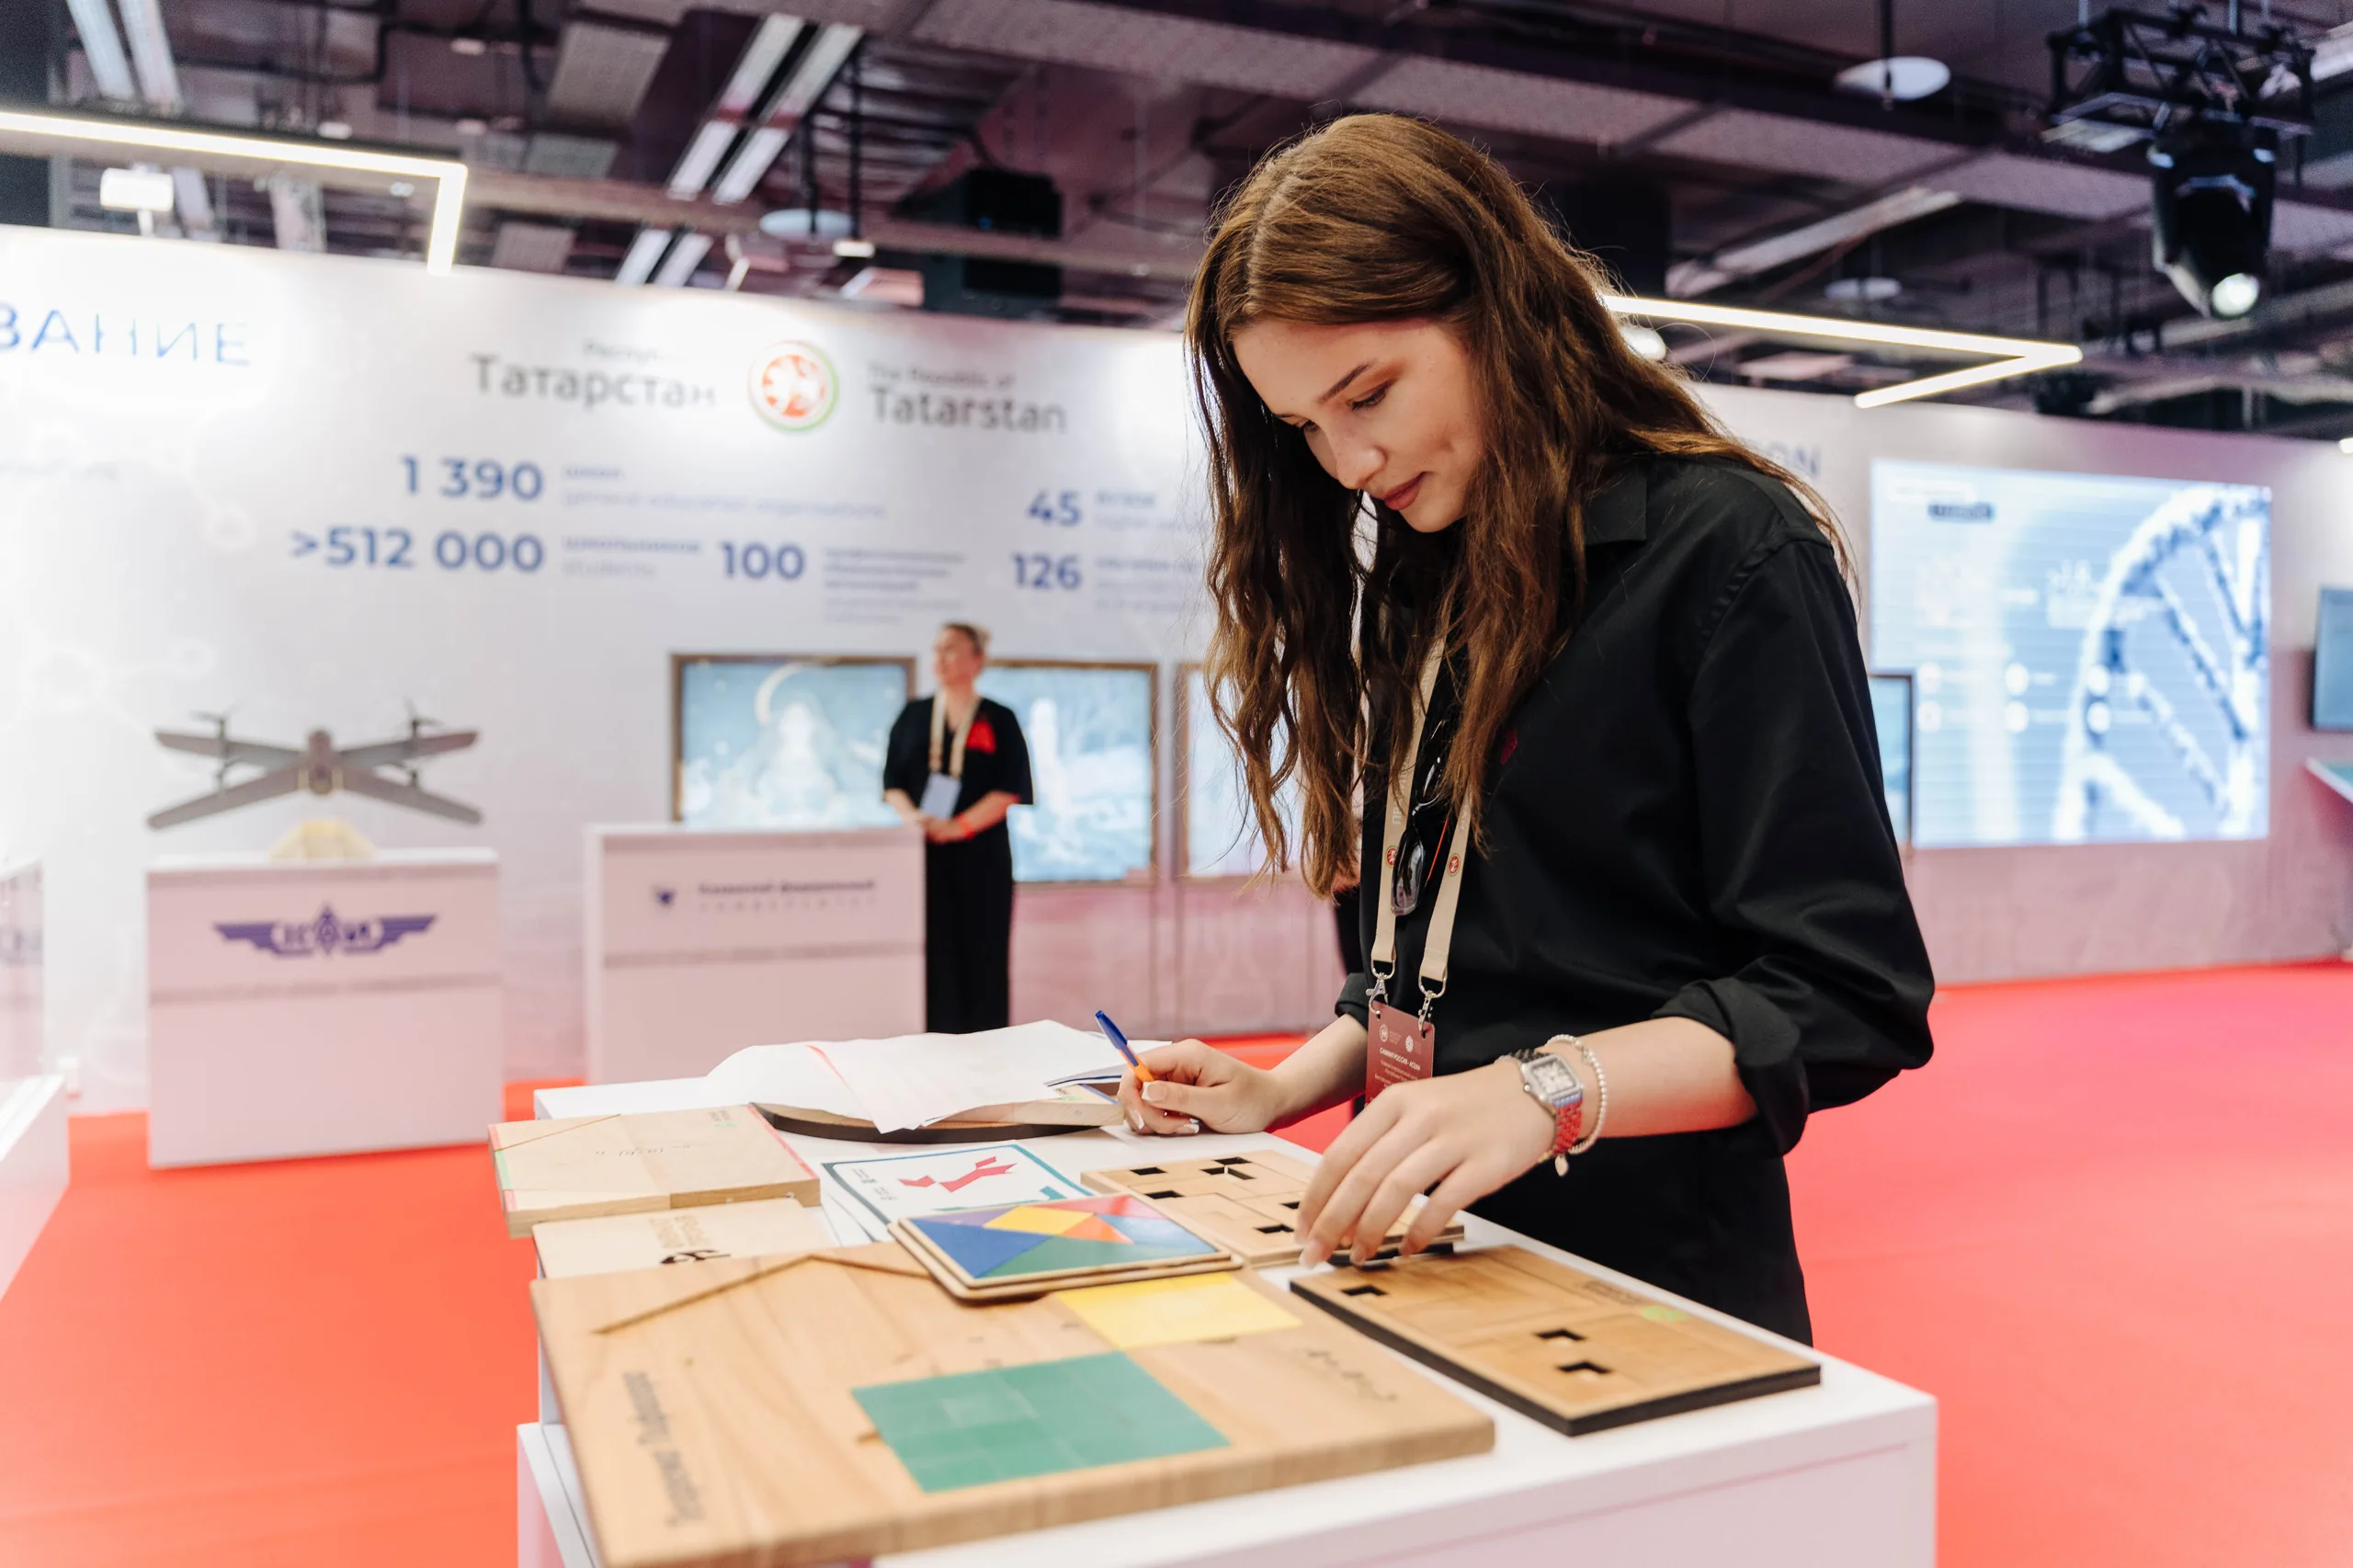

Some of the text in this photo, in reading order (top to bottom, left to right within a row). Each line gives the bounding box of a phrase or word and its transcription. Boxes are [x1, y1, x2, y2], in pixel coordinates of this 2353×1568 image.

[470, 353, 716, 412] Татарстан
[870, 385, 1068, 434] Tatarstan
[440, 458, 544, 501] 390
[1026, 488, 1083, 527] 45
[290, 527, 415, 568] >512
[435, 529, 544, 572] 000
[720, 540, 806, 581] 100
[1012, 553, 1083, 590] 126
